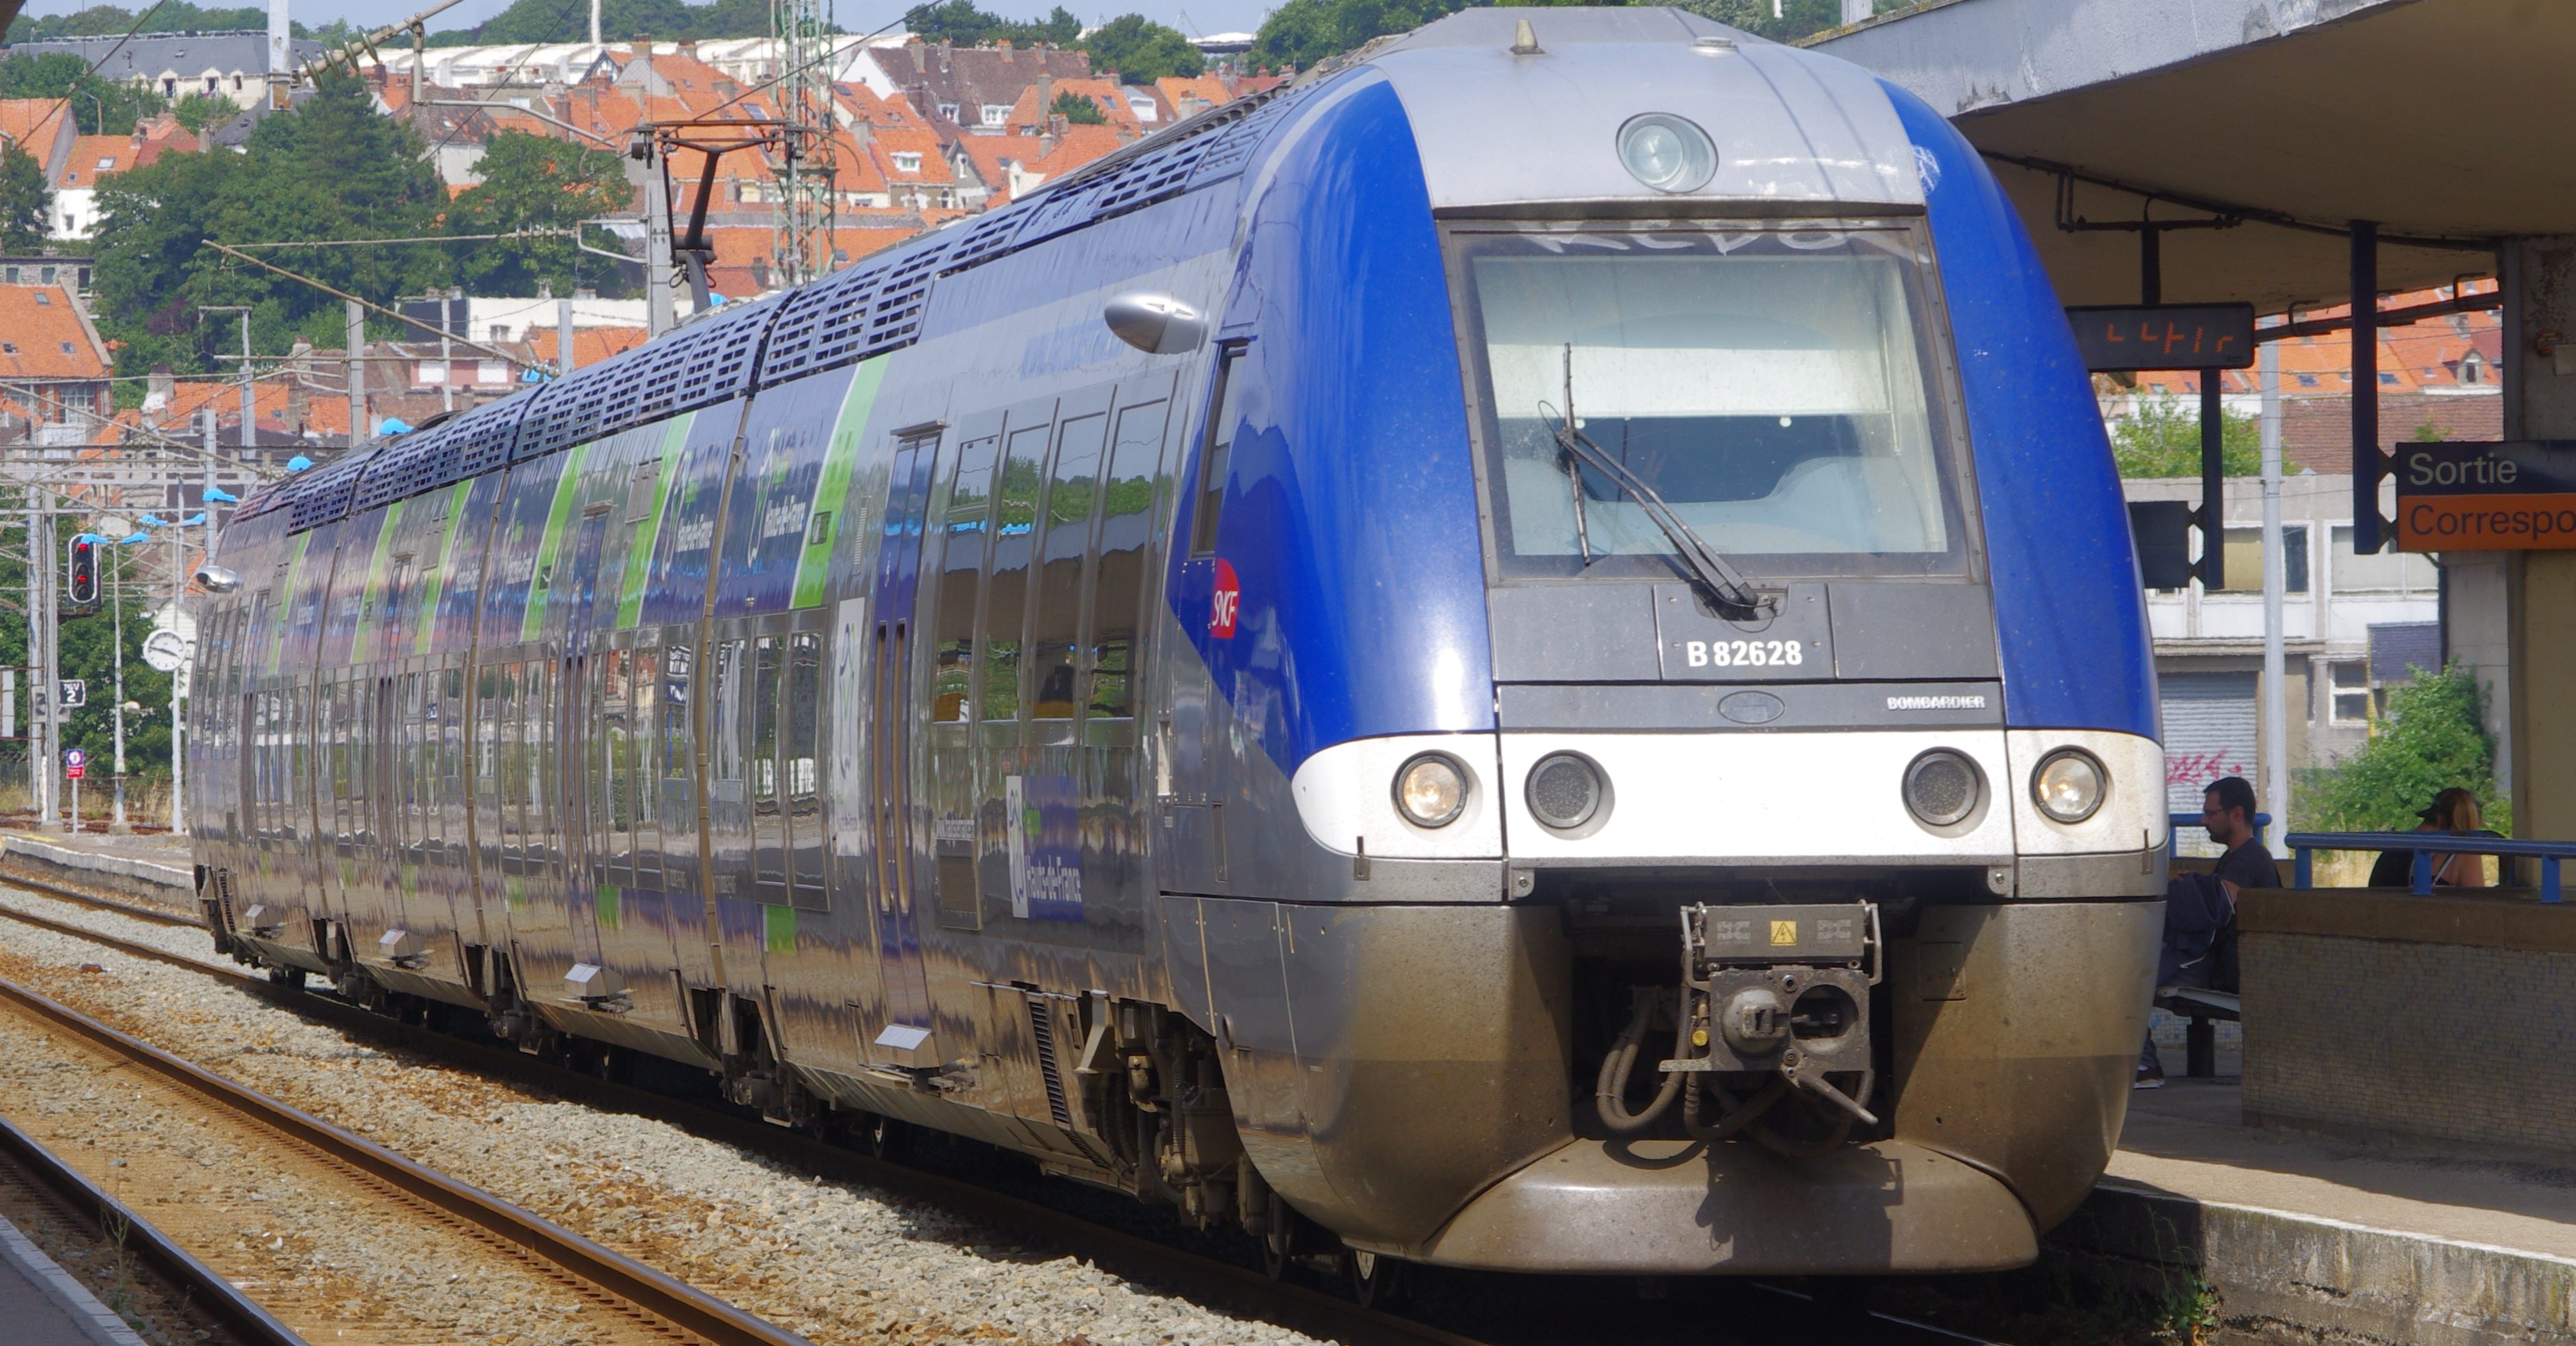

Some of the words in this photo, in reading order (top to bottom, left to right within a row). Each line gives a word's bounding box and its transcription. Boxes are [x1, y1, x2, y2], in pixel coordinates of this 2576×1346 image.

[2410, 452, 2517, 485] Sortie
[2411, 505, 2576, 540] Correspo
[1212, 590, 1238, 627] SNCF
[1687, 641, 1708, 666] B
[1714, 641, 1803, 666] 82628
[67, 690, 76, 702] 2
[1887, 696, 1985, 710] BOMBARDIER
[1025, 854, 1081, 902] Hauts-de-France
